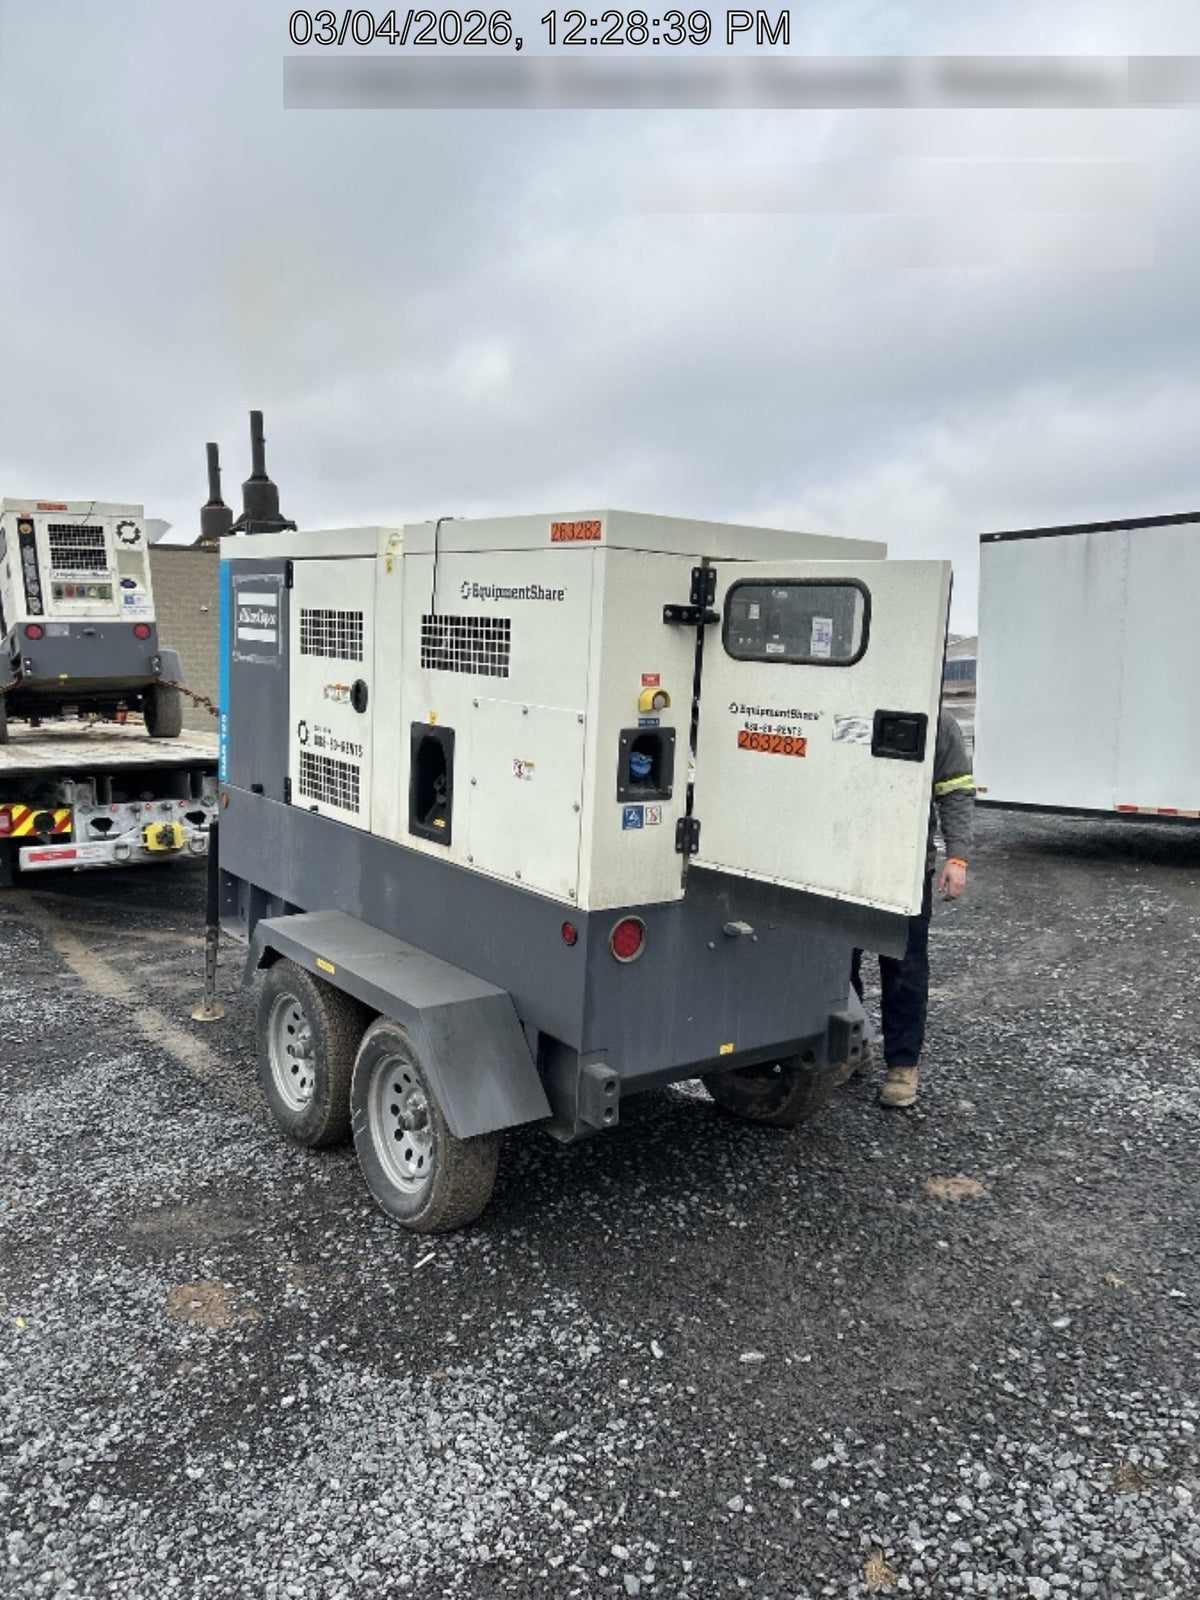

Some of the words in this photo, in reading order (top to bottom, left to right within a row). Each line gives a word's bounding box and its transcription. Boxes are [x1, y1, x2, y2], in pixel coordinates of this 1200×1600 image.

[551, 520, 601, 542] 263282
[472, 583, 565, 602] EquipmentShare
[738, 731, 807, 757] 263282
